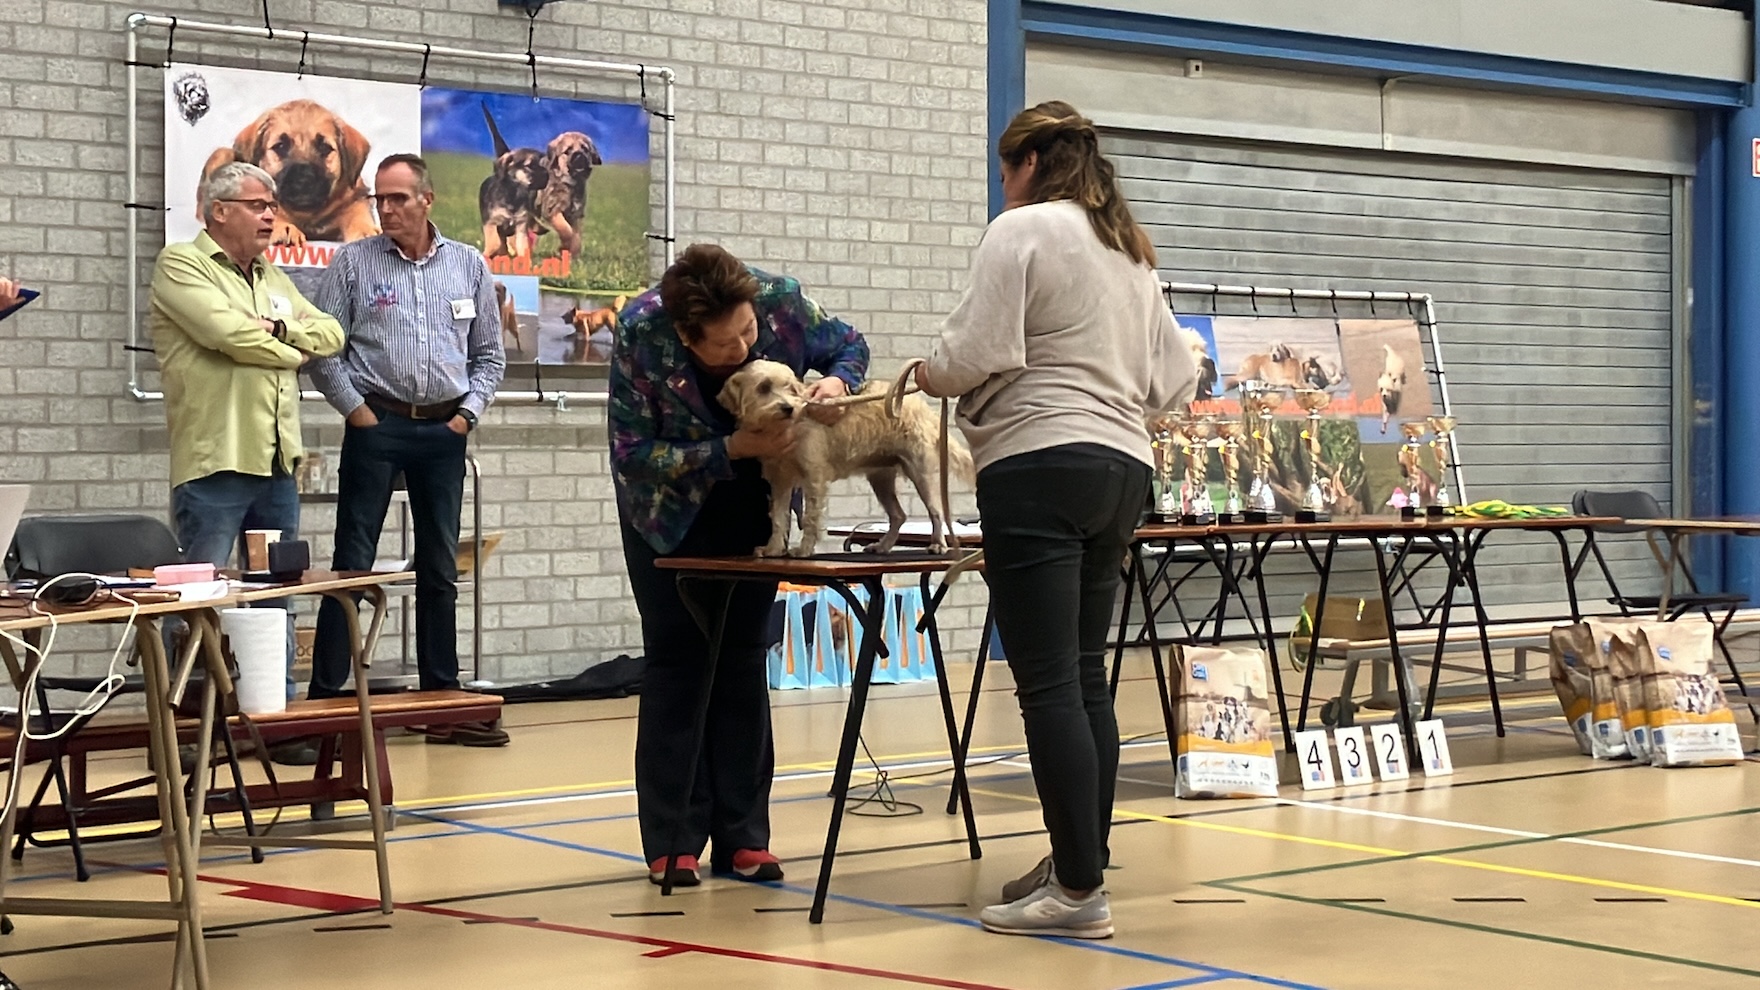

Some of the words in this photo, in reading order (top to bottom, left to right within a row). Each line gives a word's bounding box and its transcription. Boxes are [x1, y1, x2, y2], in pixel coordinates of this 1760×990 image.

[1307, 740, 1323, 771] 4
[1344, 737, 1361, 768] 3
[1382, 733, 1399, 764] 2
[1427, 729, 1439, 760] 1
